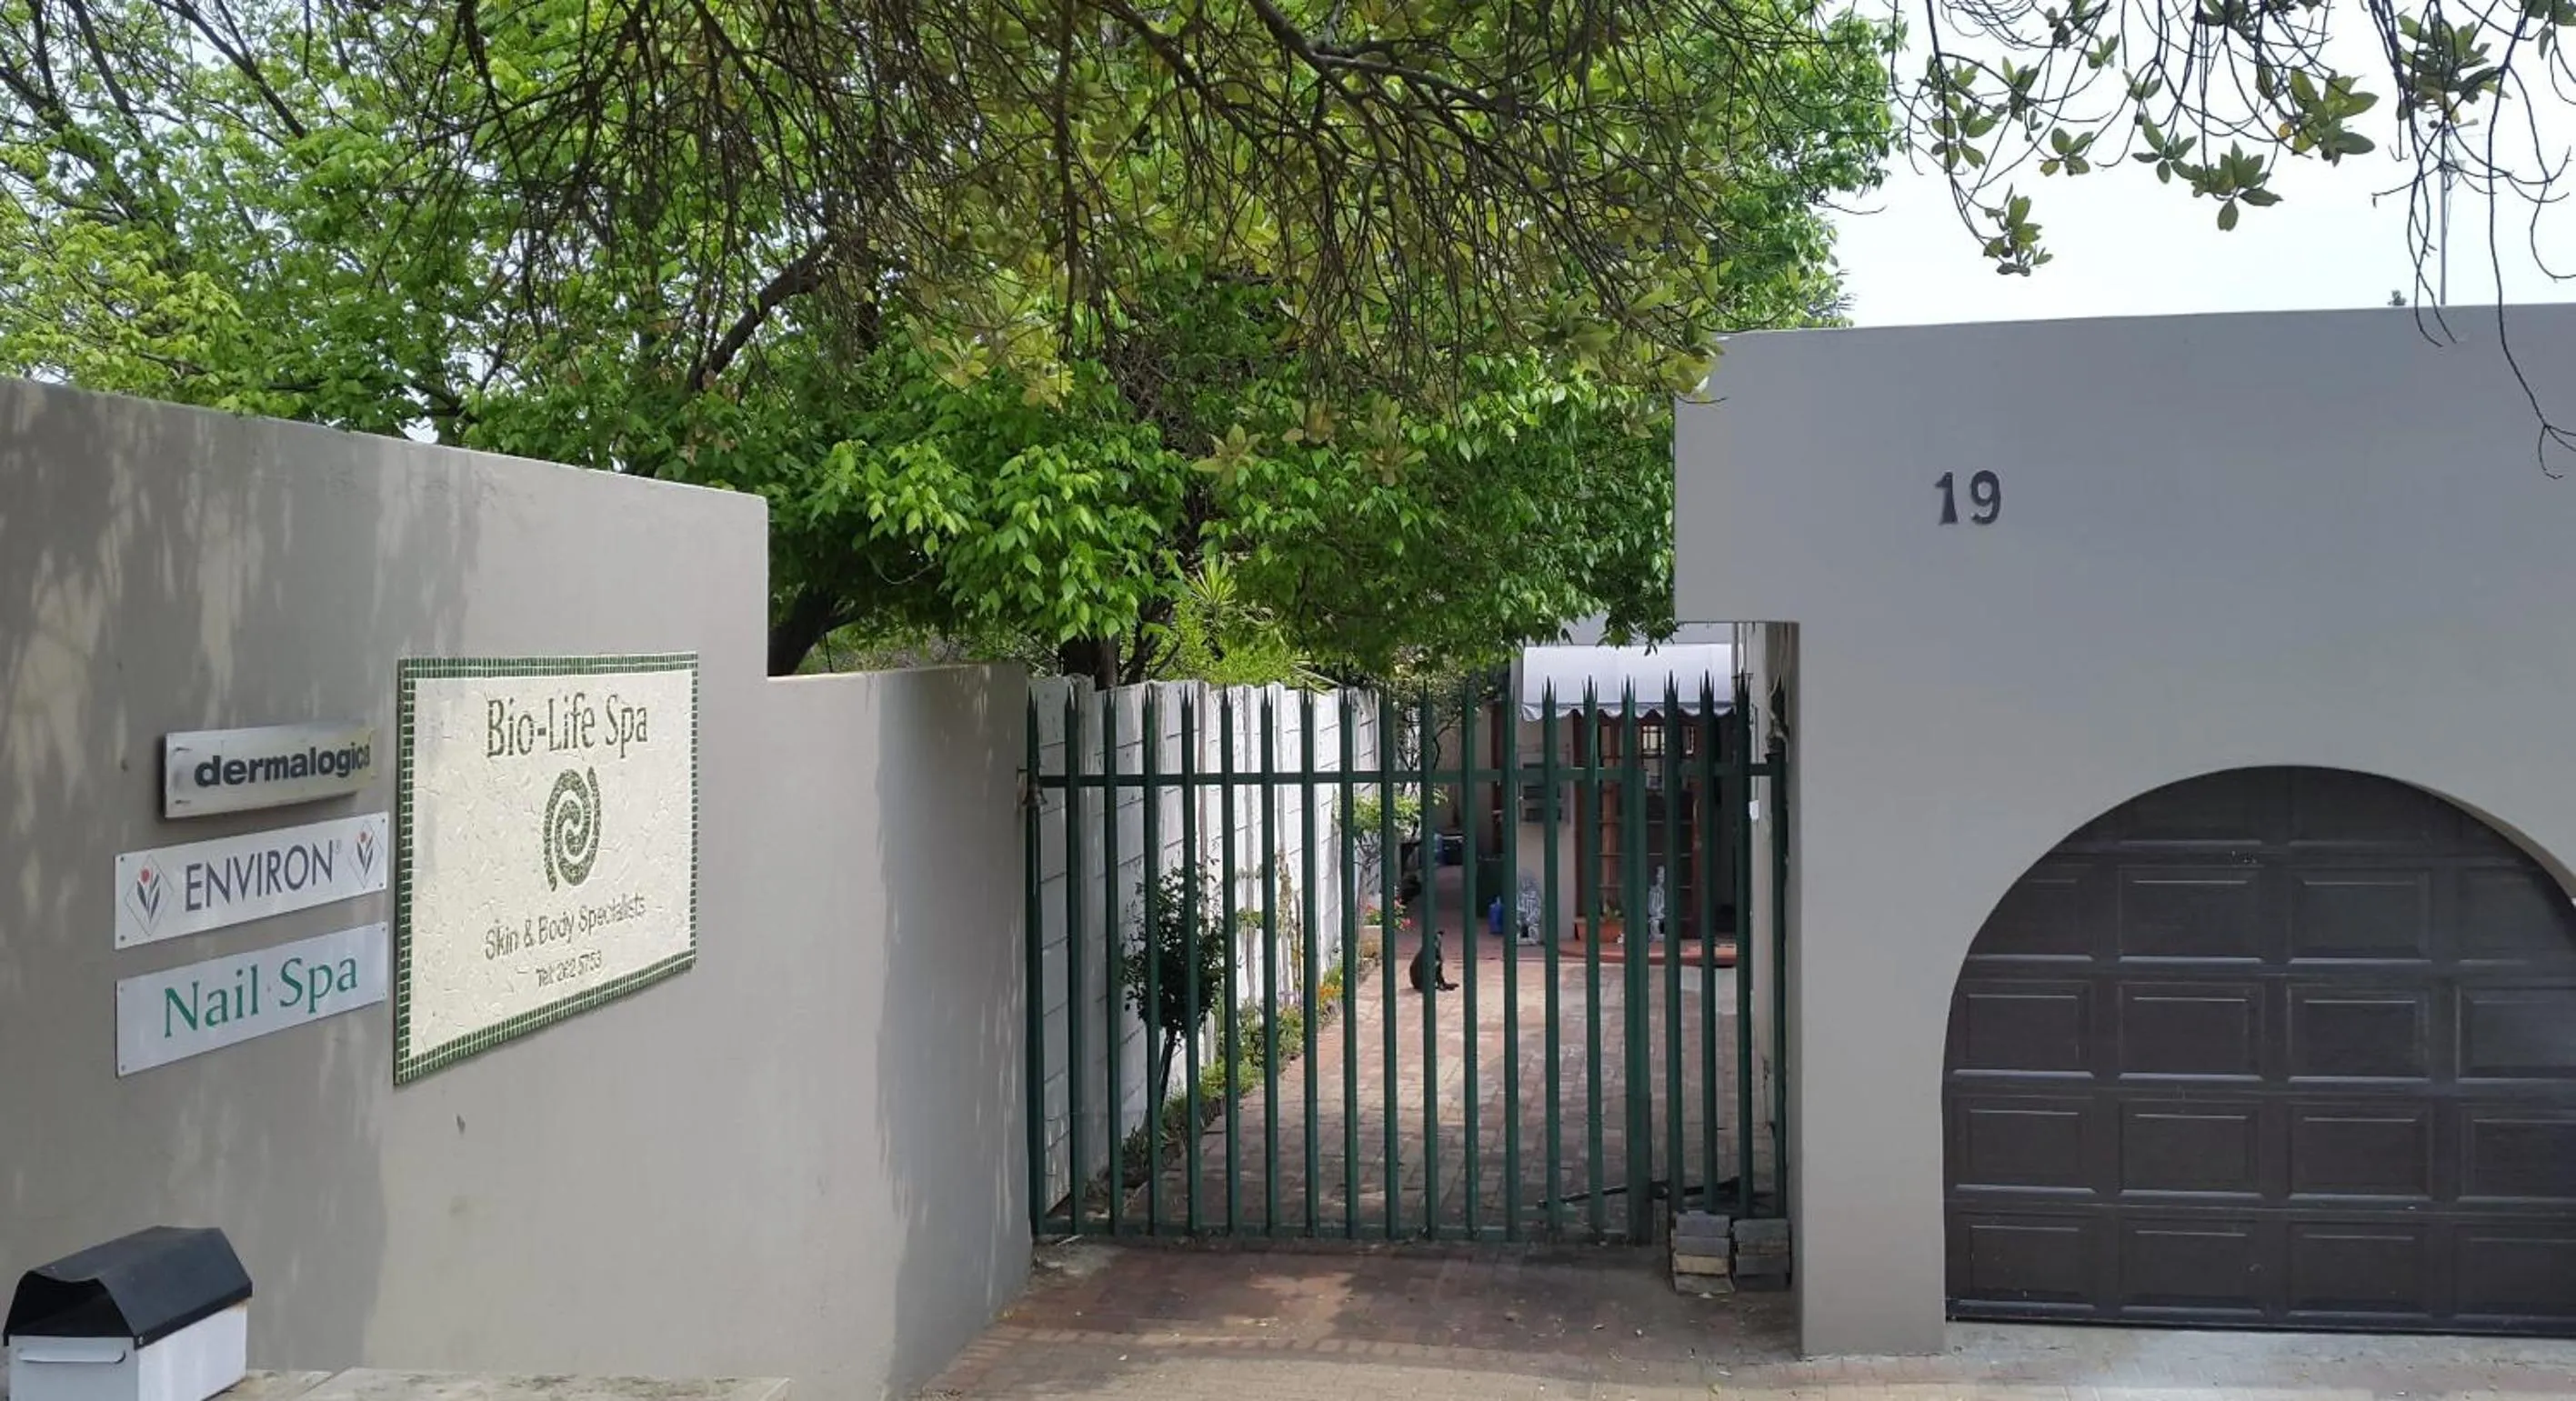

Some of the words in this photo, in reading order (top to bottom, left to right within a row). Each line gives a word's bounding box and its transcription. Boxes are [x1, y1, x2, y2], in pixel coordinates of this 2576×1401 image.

[1934, 469, 2001, 525] 19
[487, 693, 596, 757] Bio-Life
[606, 694, 648, 758] Spa
[194, 741, 371, 787] dermalogica
[185, 839, 334, 911] ENVIRON
[485, 919, 518, 960] Skin
[523, 919, 535, 947] &
[538, 911, 575, 944] Body
[577, 893, 646, 936] Specialists
[164, 965, 259, 1037] Nail
[279, 957, 357, 1014] Spa
